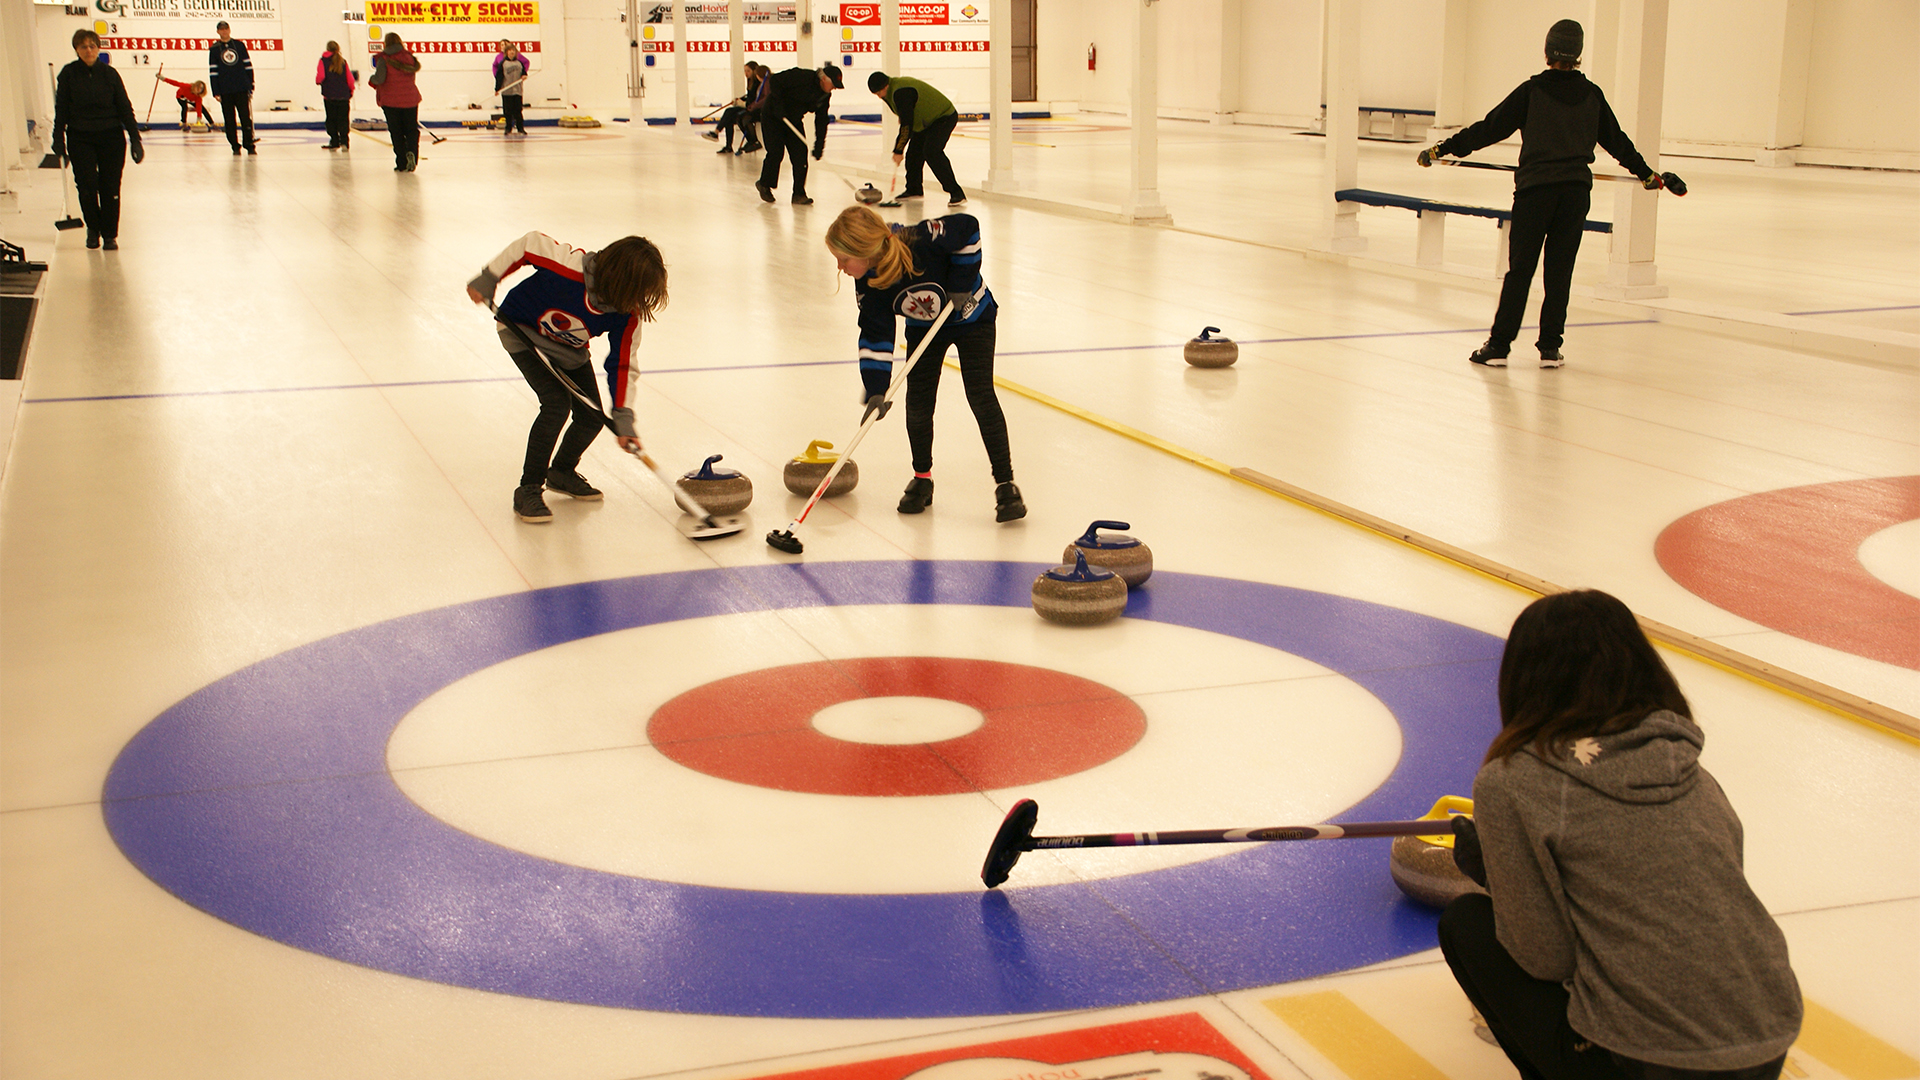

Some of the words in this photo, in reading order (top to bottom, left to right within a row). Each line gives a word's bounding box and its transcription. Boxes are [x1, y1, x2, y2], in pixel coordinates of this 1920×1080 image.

[65, 5, 88, 16] BLANK
[371, 3, 424, 15] WINK
[430, 3, 471, 15] CITY
[478, 3, 533, 15] SIGNS
[703, 4, 728, 12] Hond
[344, 13, 364, 21] BLANK
[821, 15, 838, 23] BLANK
[111, 24, 117, 33] 3
[114, 39, 118, 49] 1
[122, 39, 128, 49] 2
[132, 39, 138, 49] 3
[142, 39, 148, 49] 4
[151, 39, 158, 49] 5
[161, 39, 167, 49] 6
[170, 39, 177, 49] 7
[180, 39, 187, 49] 8
[190, 39, 196, 49] 9
[200, 39, 209, 49] 10
[252, 39, 261, 49] 14
[265, 39, 275, 49] 15
[411, 43, 417, 52] 4
[420, 43, 426, 52] 5
[429, 43, 435, 52] 6
[438, 43, 443, 52] 7
[447, 43, 452, 52] 8
[455, 43, 461, 52] 9
[464, 43, 473, 52] 10
[476, 43, 484, 52] 11
[487, 43, 496, 52] 12
[524, 43, 533, 52] 15
[658, 43, 662, 52] 1
[666, 43, 671, 52] 2
[690, 43, 695, 52] 5
[698, 43, 703, 52] 6
[706, 43, 711, 52] 7
[714, 43, 719, 52] 8
[722, 43, 727, 52] 9
[752, 43, 760, 52] 12
[763, 43, 771, 52] 13
[774, 43, 782, 52] 14
[786, 43, 794, 52] 15
[856, 42, 860, 51] 1
[863, 42, 867, 51] 2
[870, 42, 875, 51] 3
[901, 42, 905, 51] 7
[908, 42, 913, 51] 8
[916, 42, 921, 51] 9
[924, 42, 932, 51] 10
[935, 42, 941, 51] 11
[944, 42, 952, 51] 12
[955, 42, 962, 51] 13
[966, 42, 973, 51] 14
[977, 42, 984, 51] 15
[133, 55, 138, 64] 1
[143, 55, 149, 64] 2
